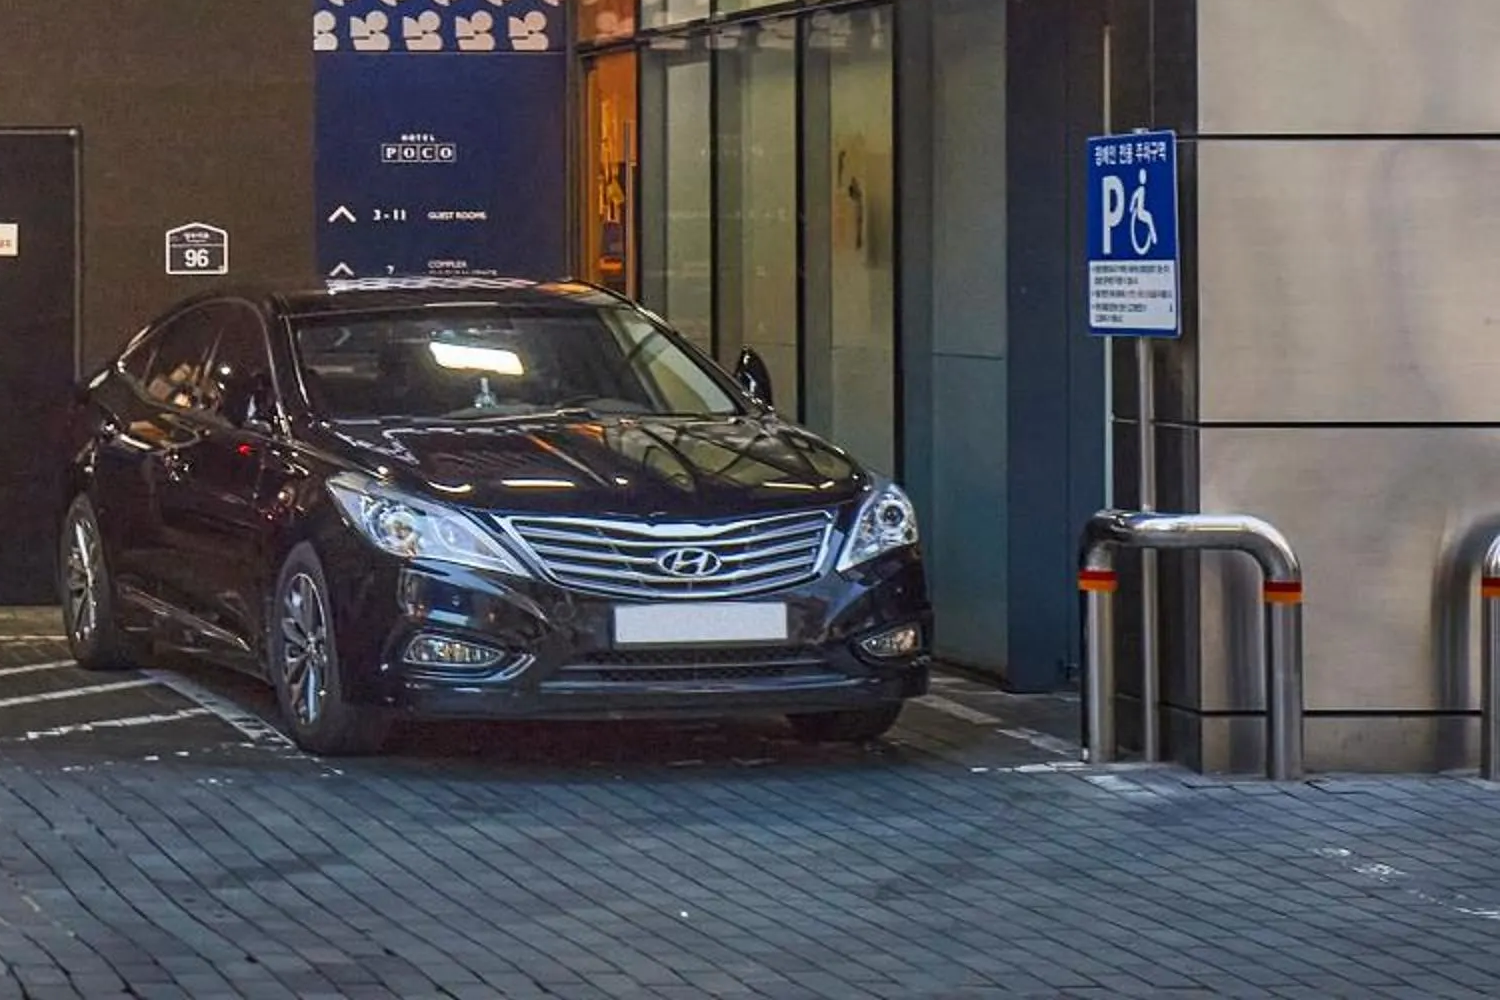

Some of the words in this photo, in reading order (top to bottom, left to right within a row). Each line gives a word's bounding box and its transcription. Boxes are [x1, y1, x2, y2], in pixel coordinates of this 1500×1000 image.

[385, 146, 453, 160] POCO
[1102, 175, 1126, 255] P
[185, 249, 209, 267] 96
